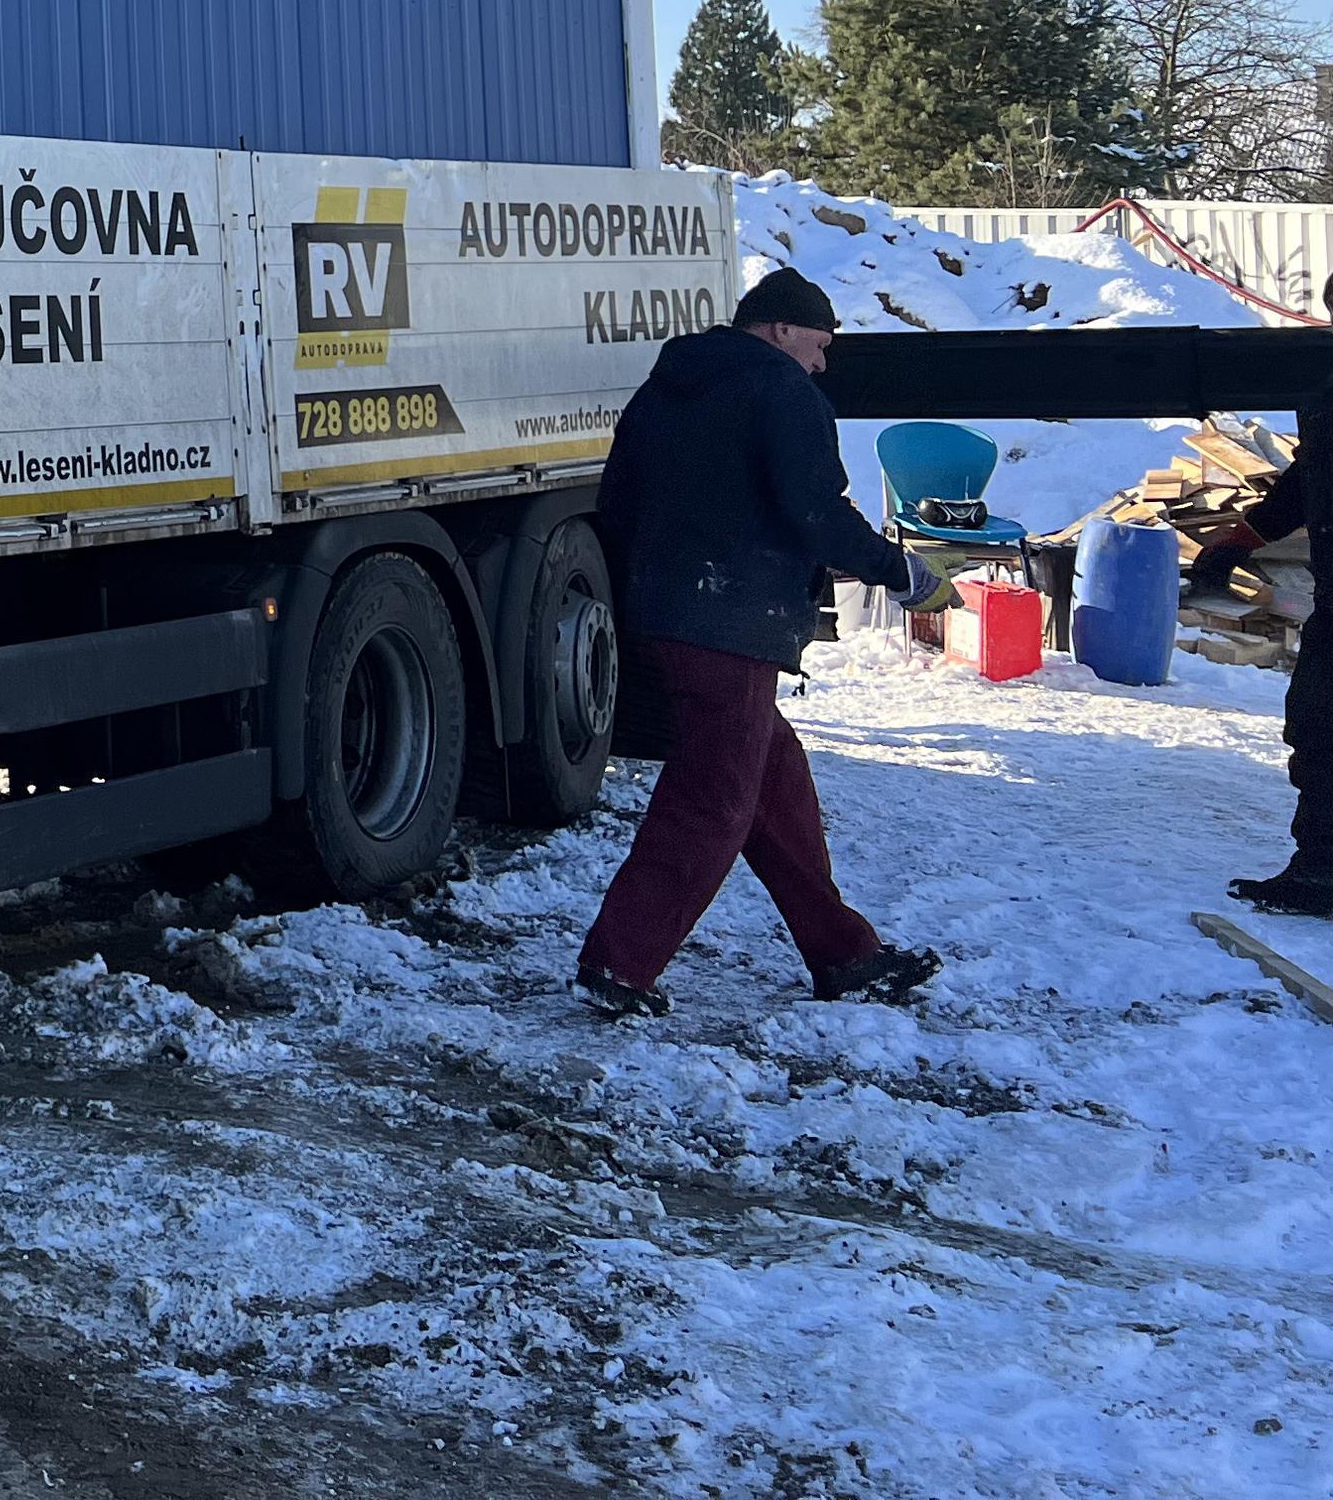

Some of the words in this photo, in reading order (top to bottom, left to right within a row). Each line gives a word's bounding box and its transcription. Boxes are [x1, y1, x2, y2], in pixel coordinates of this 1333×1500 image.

[459, 201, 711, 258] AUTODOPRAVA
[307, 242, 393, 319] RV
[584, 287, 716, 344] KLADNO
[301, 342, 383, 357] AUTODOPRAVA
[297, 400, 342, 440] 728
[347, 397, 392, 436] 888
[396, 393, 438, 431] 898
